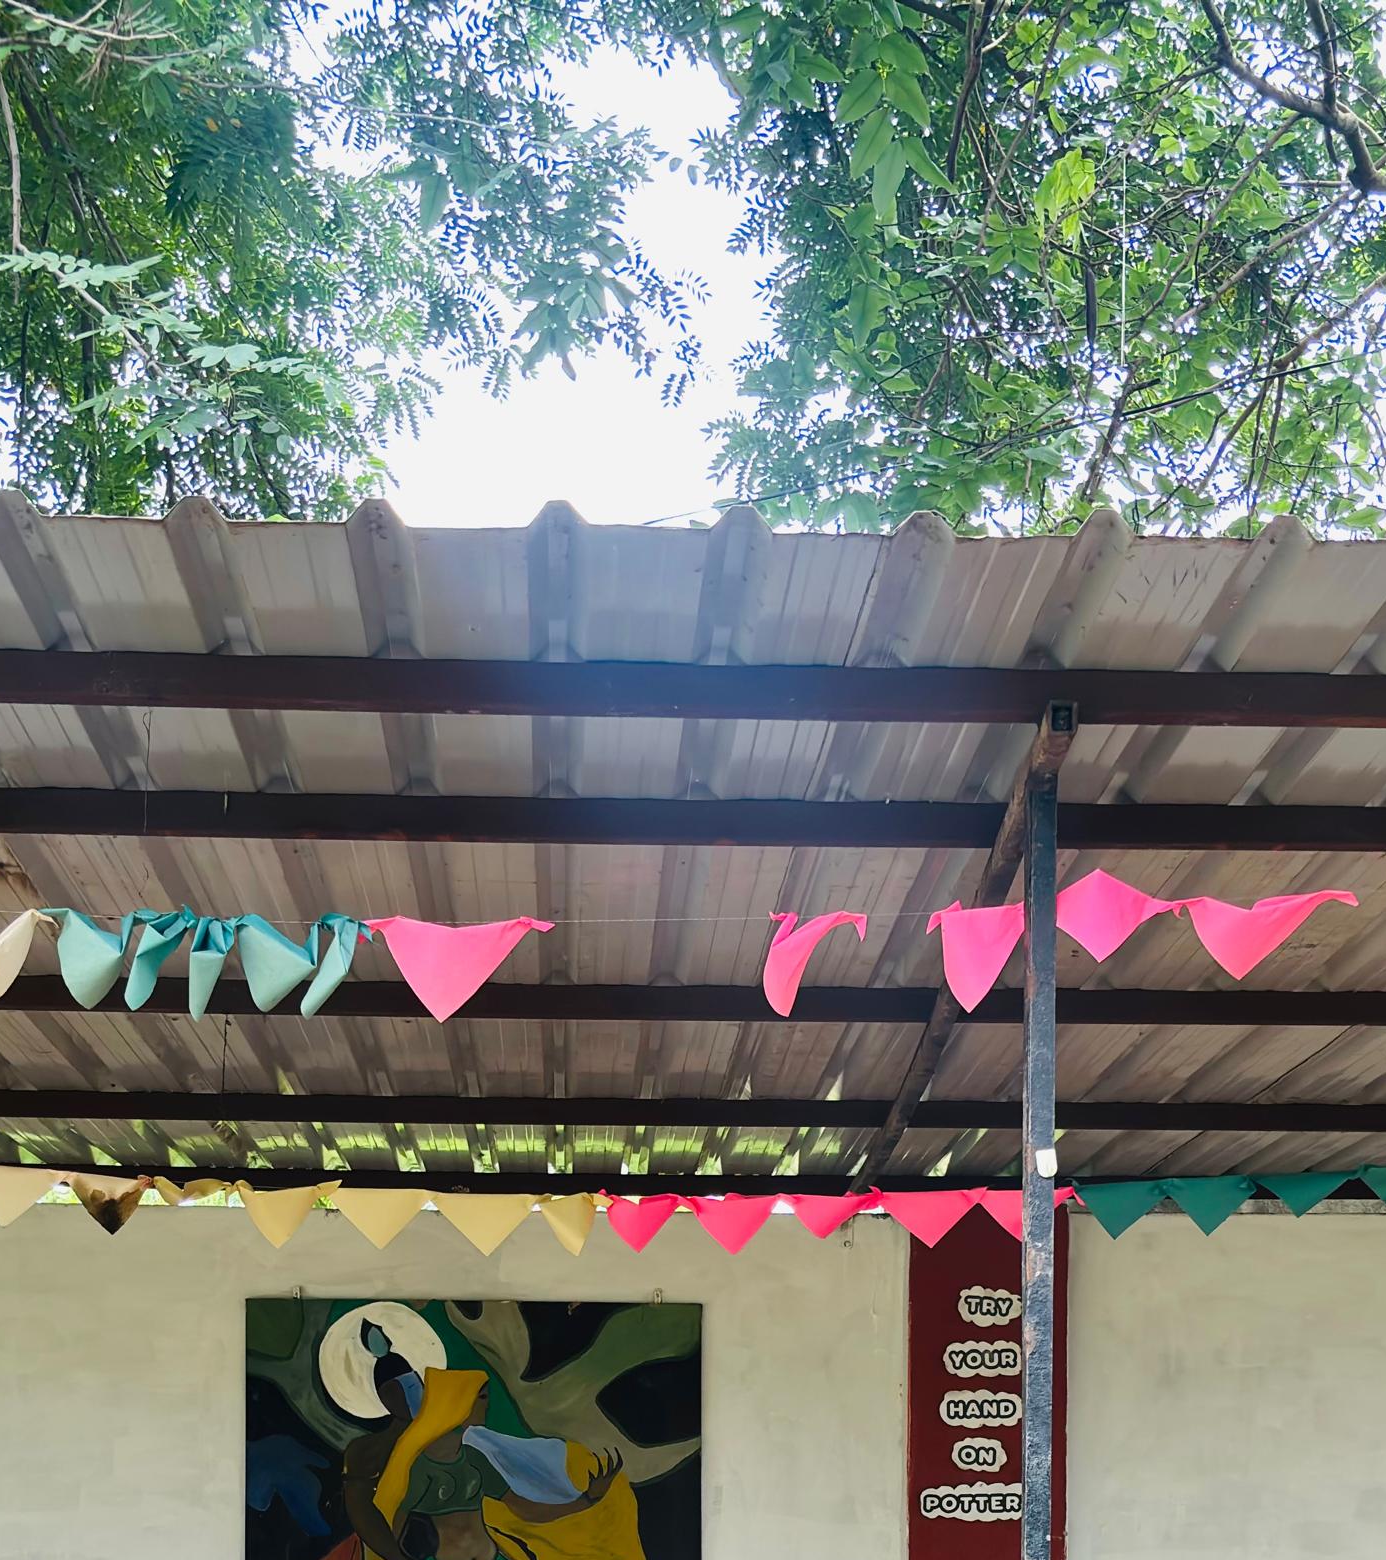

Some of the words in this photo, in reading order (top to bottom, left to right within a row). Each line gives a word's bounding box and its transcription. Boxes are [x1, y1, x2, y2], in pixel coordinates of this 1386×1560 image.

[964, 1296, 1013, 1316] TRY
[948, 1349, 1017, 1369] YOUR
[946, 1399, 1016, 1419] HAND
[958, 1445, 996, 1465] ON
[923, 1493, 1023, 1513] POTTER
